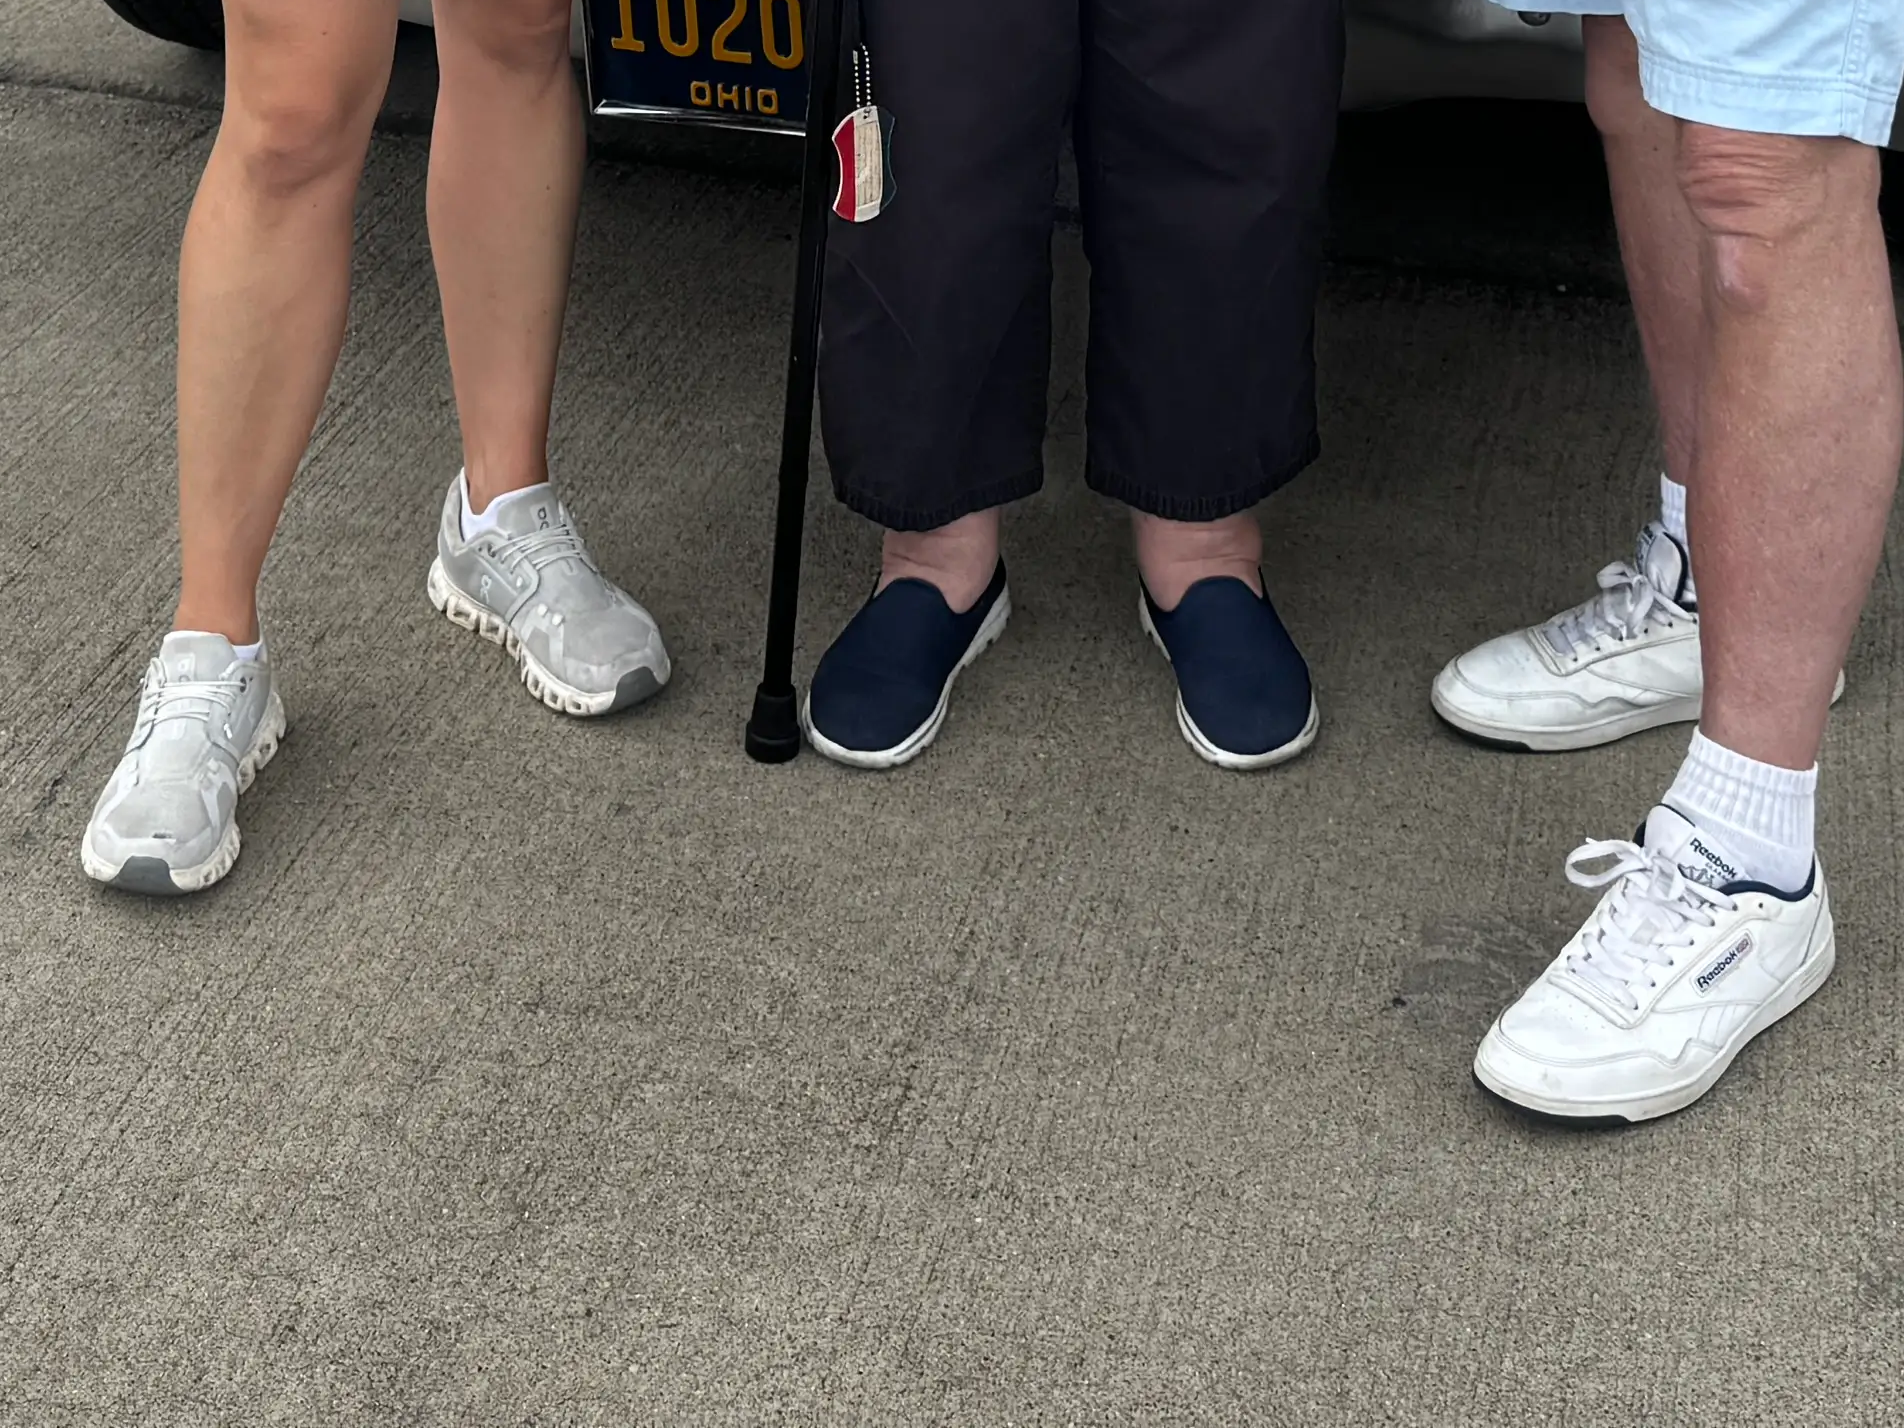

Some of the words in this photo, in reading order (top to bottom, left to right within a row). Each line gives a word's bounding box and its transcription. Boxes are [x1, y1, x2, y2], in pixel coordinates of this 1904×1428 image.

[690, 80, 779, 115] OHIO
[1690, 837, 1738, 879] Reebok
[1697, 950, 1738, 989] Reebok
